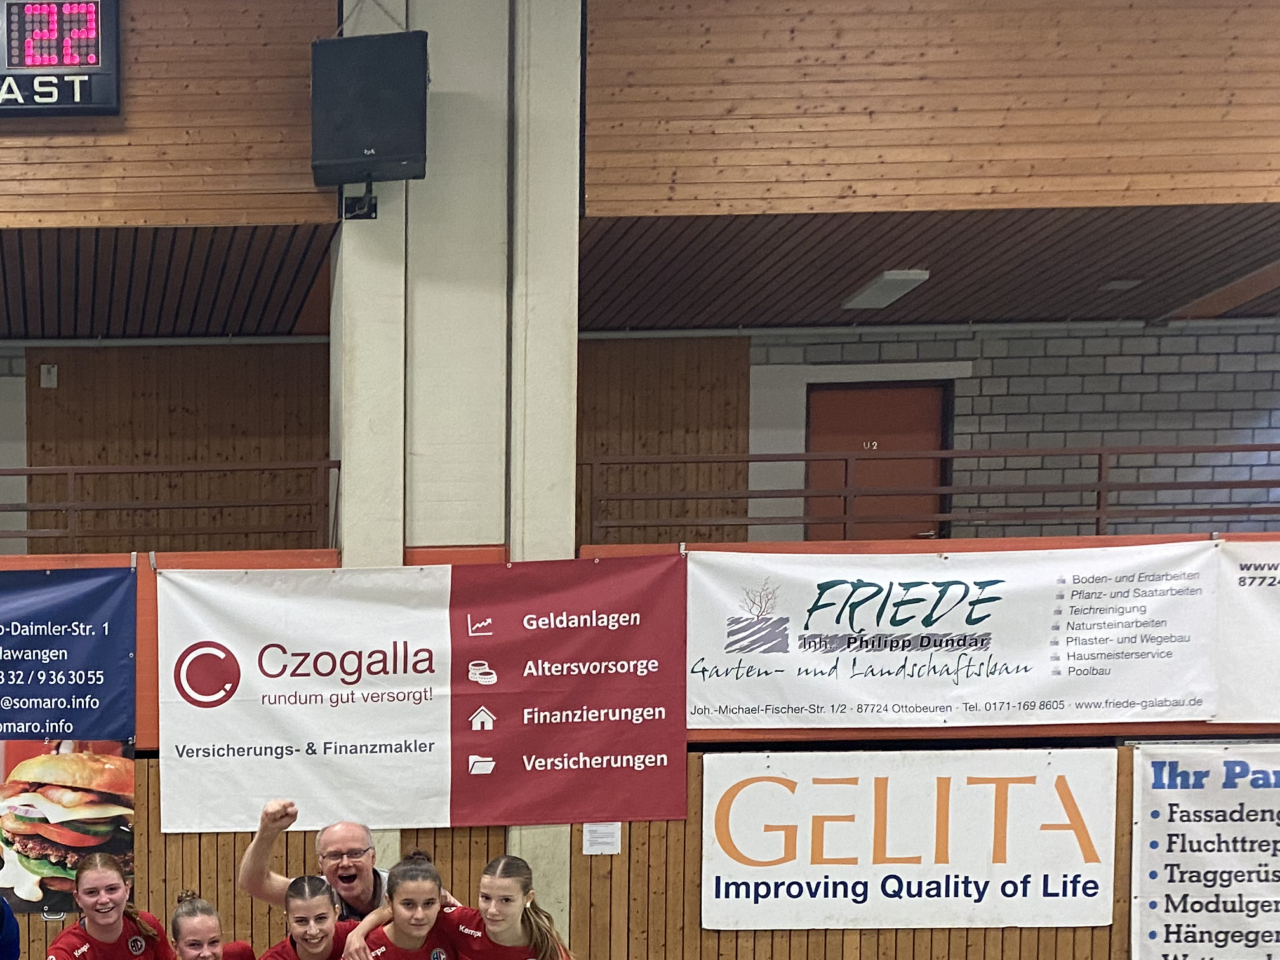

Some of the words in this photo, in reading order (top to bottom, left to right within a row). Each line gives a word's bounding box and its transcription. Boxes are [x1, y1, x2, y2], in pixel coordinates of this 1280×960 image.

[25, 3, 96, 65] 22
[1072, 574, 1113, 585] Boden-
[1115, 573, 1135, 583] und
[1138, 571, 1200, 583] Erdarbeiten
[1238, 576, 1280, 587] 8772
[1070, 589, 1107, 600] Pflanz-
[1109, 588, 1130, 599] und
[1133, 587, 1202, 598] Saatarbeiten
[804, 579, 1006, 633] FRIEDE
[1069, 604, 1147, 616] Teichreinigung
[102, 622, 109, 635] 1
[523, 610, 641, 630] Geldanlagen
[1066, 619, 1167, 631] Natursteinarbeiten
[847, 635, 912, 651] Philipp
[920, 635, 989, 648] Dundar
[1066, 636, 1114, 646] Pflaster-
[1117, 635, 1137, 645] und
[1140, 633, 1191, 645] Wegebau
[258, 641, 435, 685] Czogalla
[1067, 649, 1173, 661] Hausmeisterservice
[523, 659, 659, 676] Altersvorsorge
[690, 657, 785, 681] Garten-
[797, 656, 839, 679] und
[850, 653, 1033, 685] Landschaftsbau
[1068, 666, 1111, 676] Poolbau
[261, 692, 323, 705] rundum
[329, 690, 356, 707] gut
[361, 687, 433, 706] versorgt!
[690, 703, 826, 716] Joh.-Michael-Fischer-Str.
[830, 703, 847, 714] 1/2
[856, 703, 889, 714] 87724
[892, 702, 953, 713] Ottobeuren
[962, 701, 981, 712] Tel.
[1039, 700, 1065, 711] 8605
[1075, 697, 1203, 710] www.friede-galabau.de
[523, 706, 666, 724] Finanzierungen
[175, 743, 301, 760] Versicherungs-
[305, 742, 318, 755] &
[323, 740, 435, 755] Finanzmakler
[522, 752, 668, 771] Versicherungen
[1151, 760, 1210, 790] Ihr
[714, 775, 1102, 867] GELITA
[1167, 803, 1280, 827] Fassaden
[714, 875, 869, 904] Improving
[880, 874, 990, 904] Quality
[1000, 875, 1031, 898] of
[1042, 874, 1100, 898] Life
